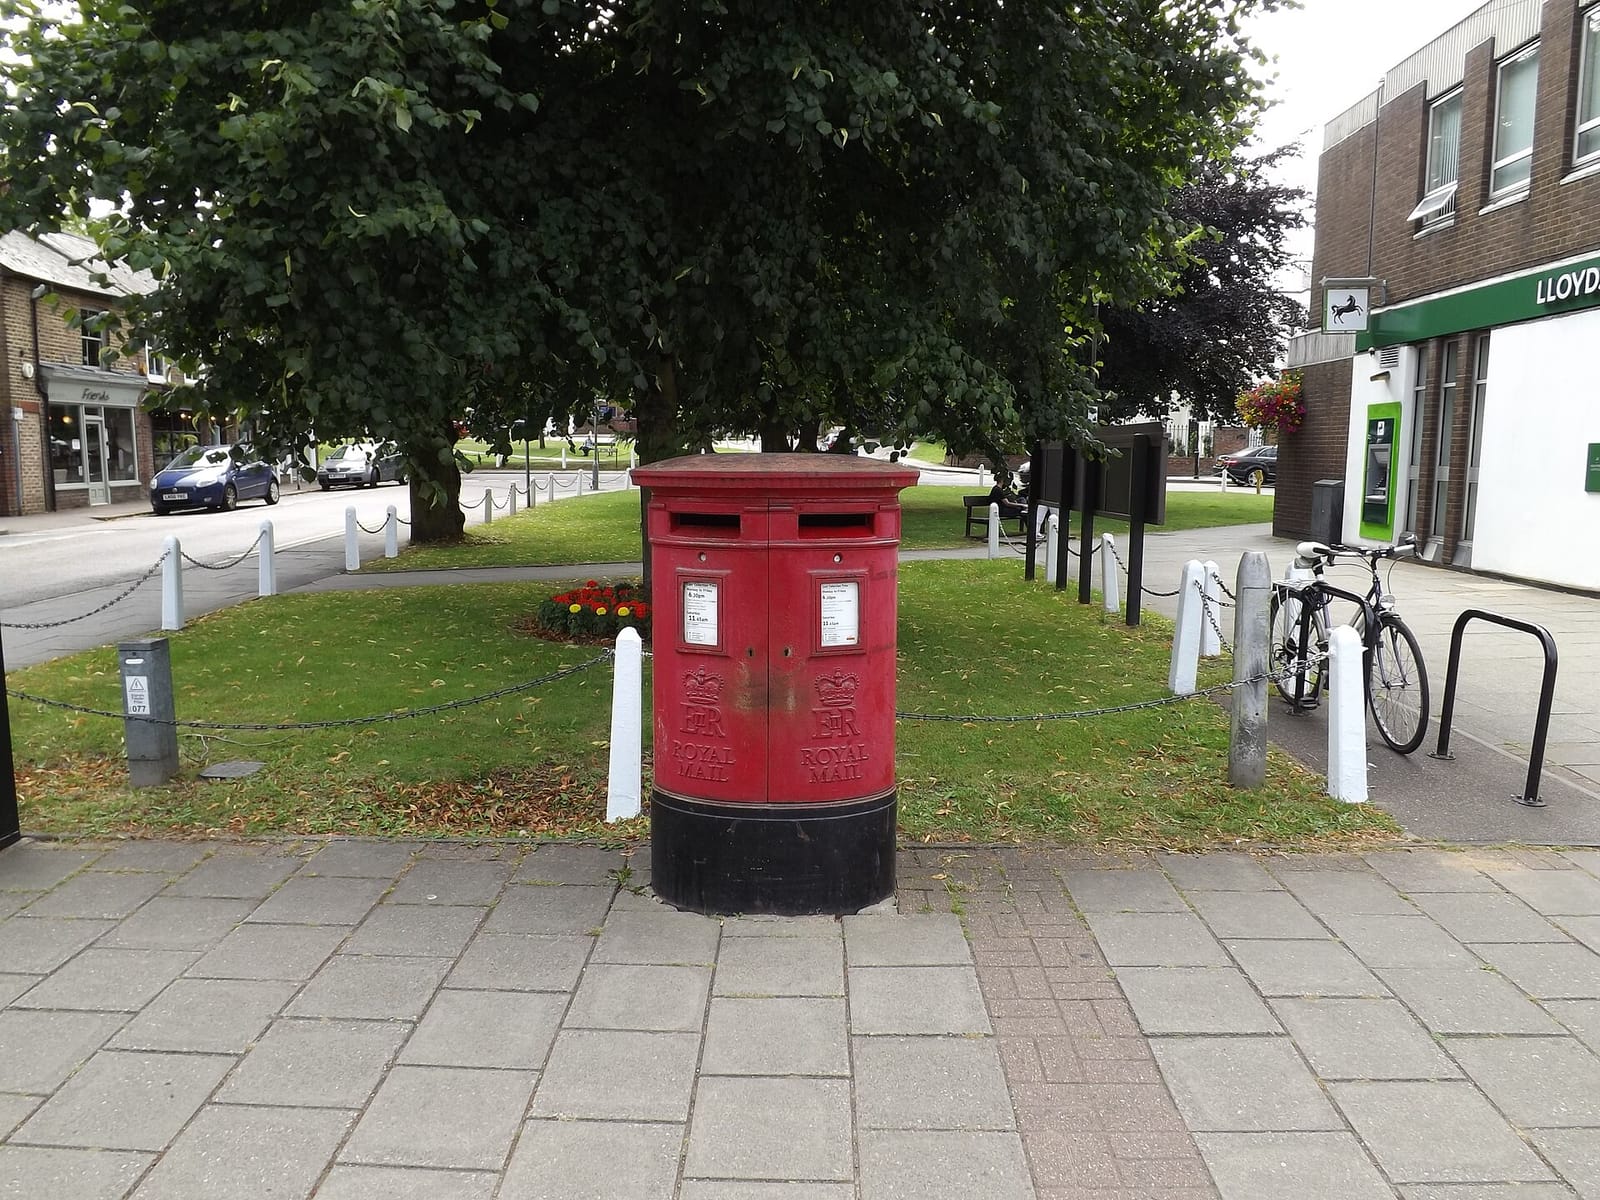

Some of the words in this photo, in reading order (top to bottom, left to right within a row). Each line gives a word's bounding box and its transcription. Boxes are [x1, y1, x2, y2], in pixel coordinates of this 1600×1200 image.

[1536, 267, 1600, 305] LLOYD
[672, 740, 736, 765] ROYAL
[800, 743, 869, 766] ROYAL
[678, 760, 729, 782] MAIL
[808, 763, 861, 783] MAIL
